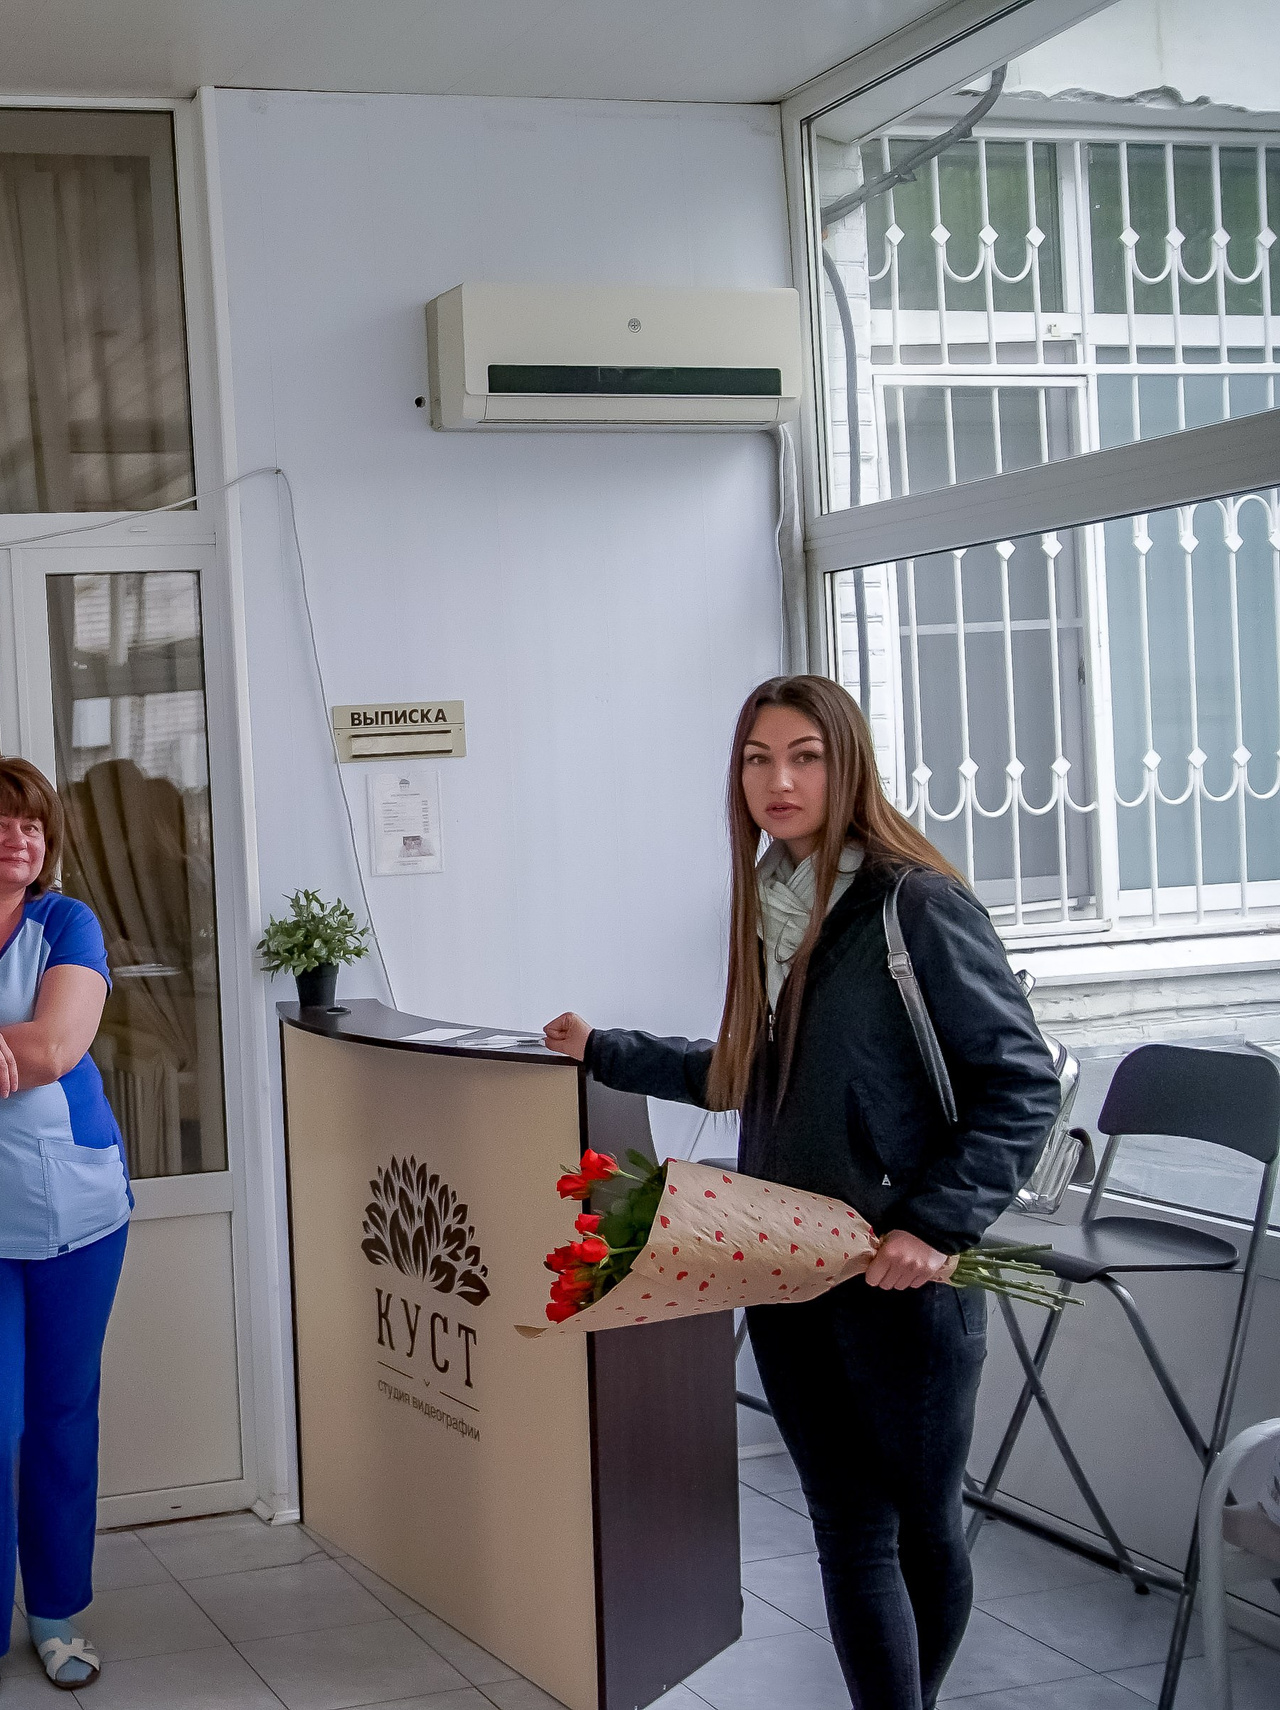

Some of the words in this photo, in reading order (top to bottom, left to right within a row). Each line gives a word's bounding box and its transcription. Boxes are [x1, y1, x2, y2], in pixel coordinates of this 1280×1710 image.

[350, 708, 448, 726] ВЫПИСКА
[375, 1287, 477, 1389] КУСТ
[377, 1379, 411, 1405] студия
[411, 1395, 481, 1442] видеографии
